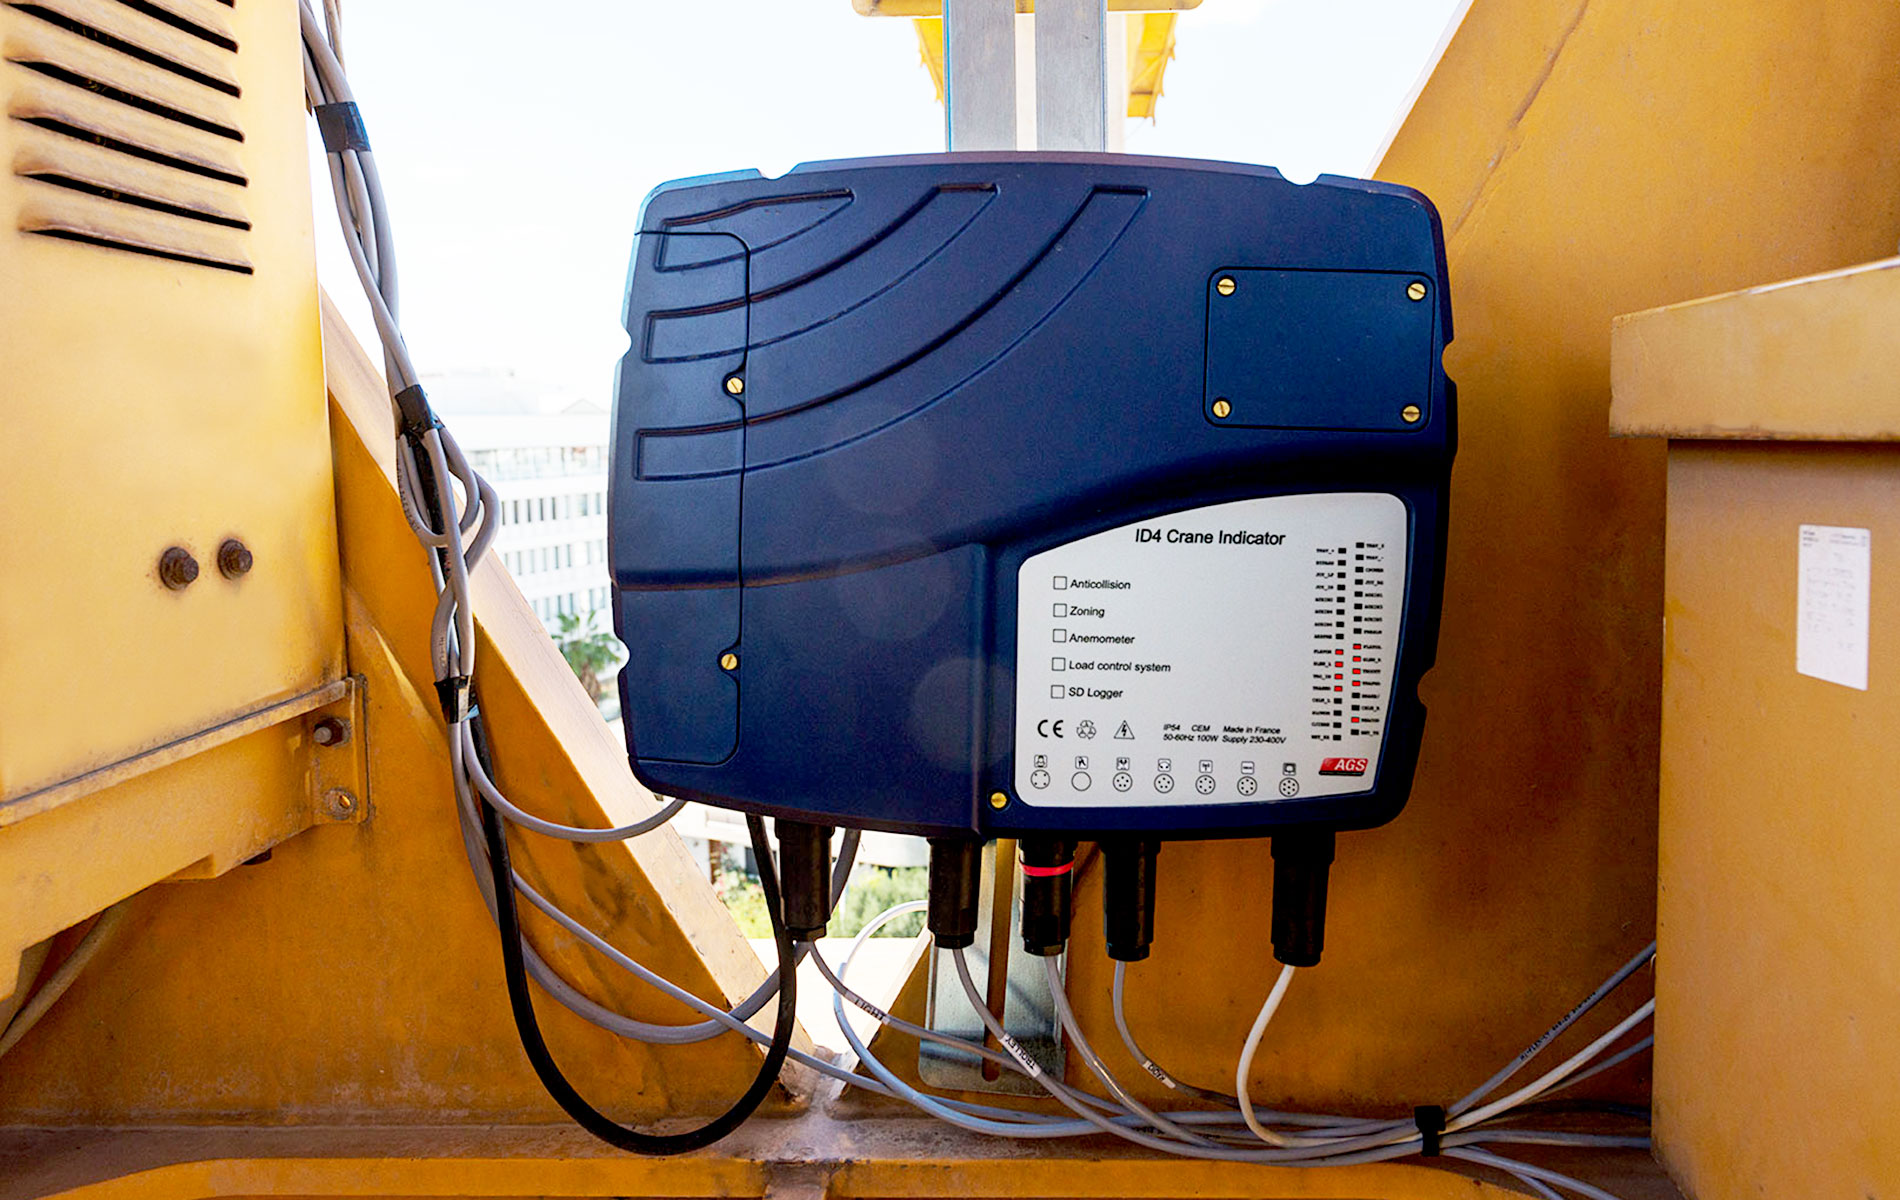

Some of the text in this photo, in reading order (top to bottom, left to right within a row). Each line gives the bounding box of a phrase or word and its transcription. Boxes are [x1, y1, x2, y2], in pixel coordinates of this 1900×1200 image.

[1135, 528, 1286, 545] ID4 Crane Indicator
[1070, 579, 1131, 589] Anticollision
[1070, 606, 1105, 618] Zoning
[1069, 633, 1135, 644] Anemometer
[1069, 661, 1171, 674] Load control system
[1068, 687, 1123, 700] SD Logger
[1222, 735, 1286, 744] Supply 230-400V
[1334, 758, 1366, 771] AGS
[854, 999, 885, 1020] LIGHT
[1005, 1037, 1035, 1071] TROLLEY
